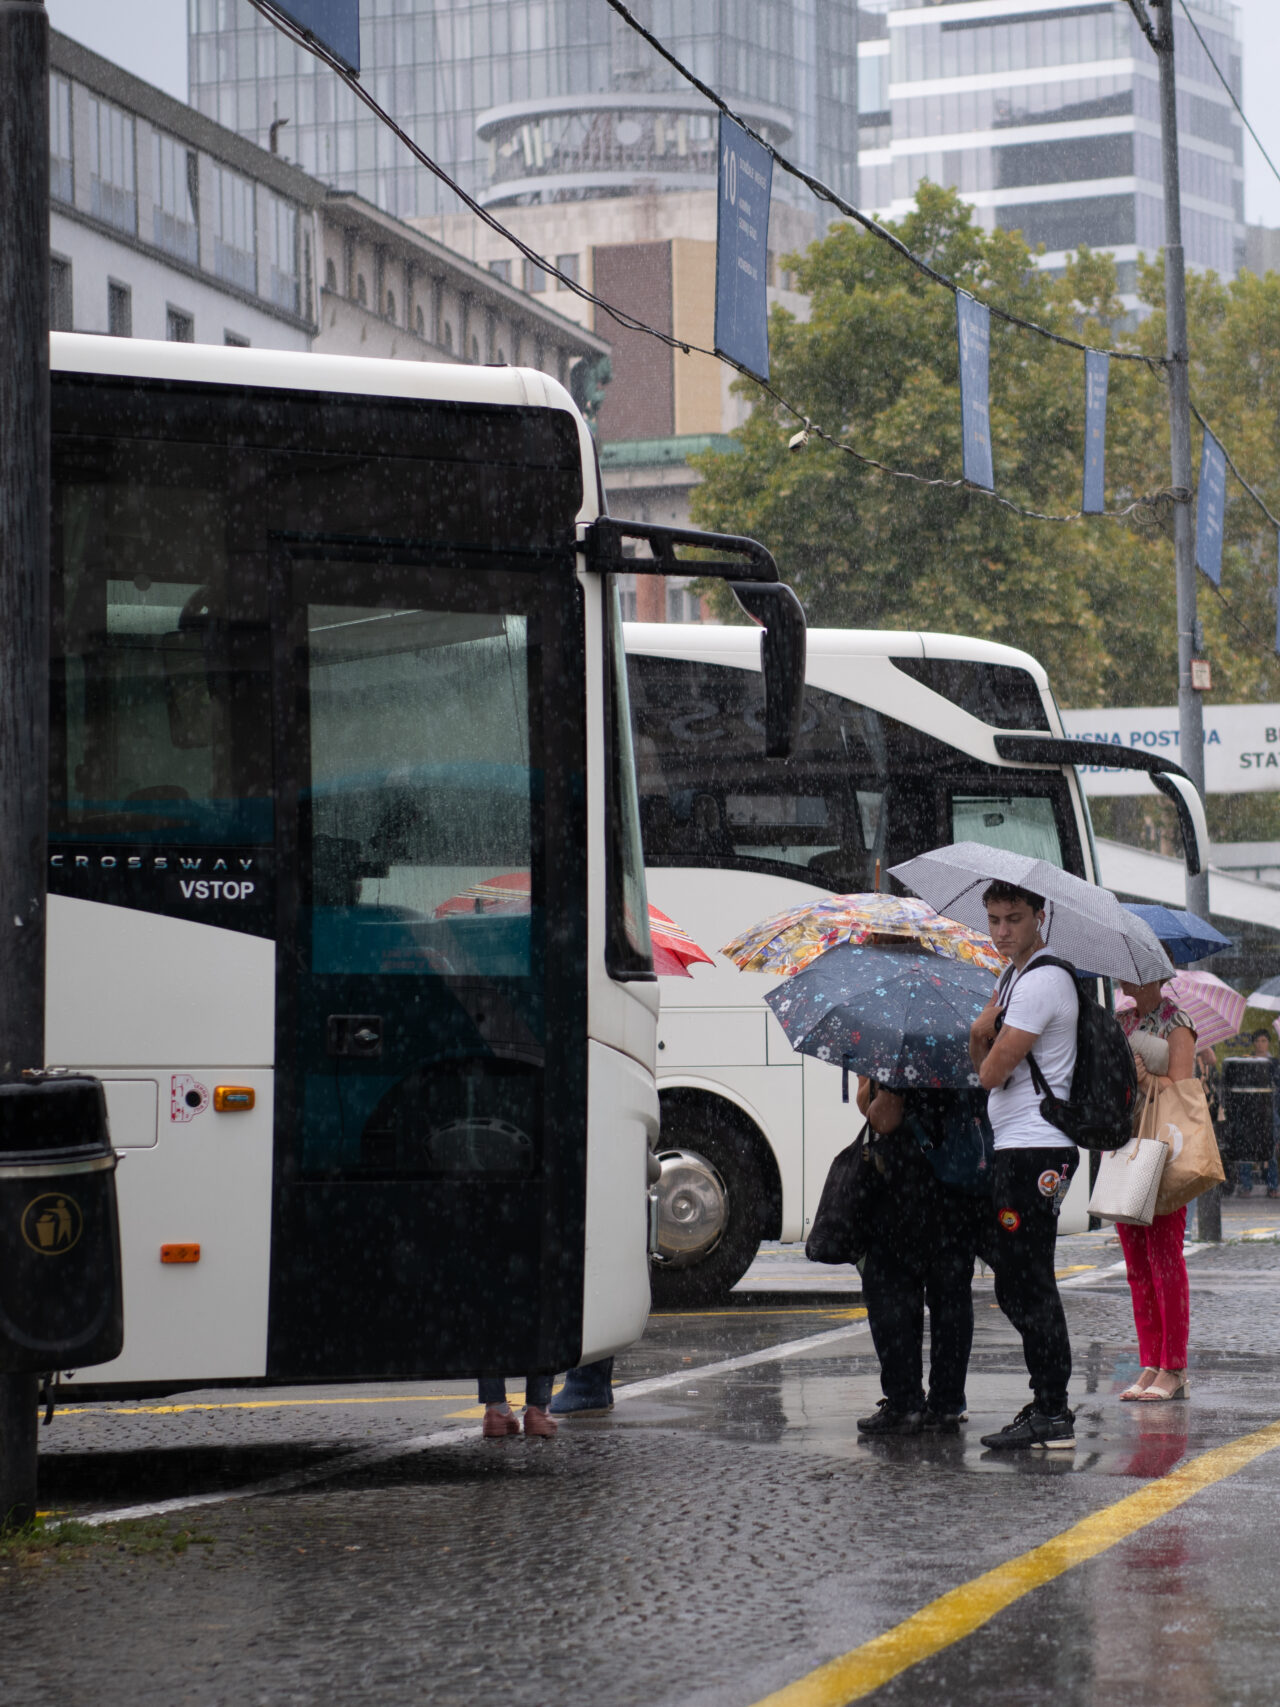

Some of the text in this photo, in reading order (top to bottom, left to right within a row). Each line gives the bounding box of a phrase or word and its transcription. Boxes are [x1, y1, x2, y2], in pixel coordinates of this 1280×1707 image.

[723, 145, 737, 206] 10
[50, 855, 252, 871] CROSSWAY
[179, 880, 255, 900] VSTOP
